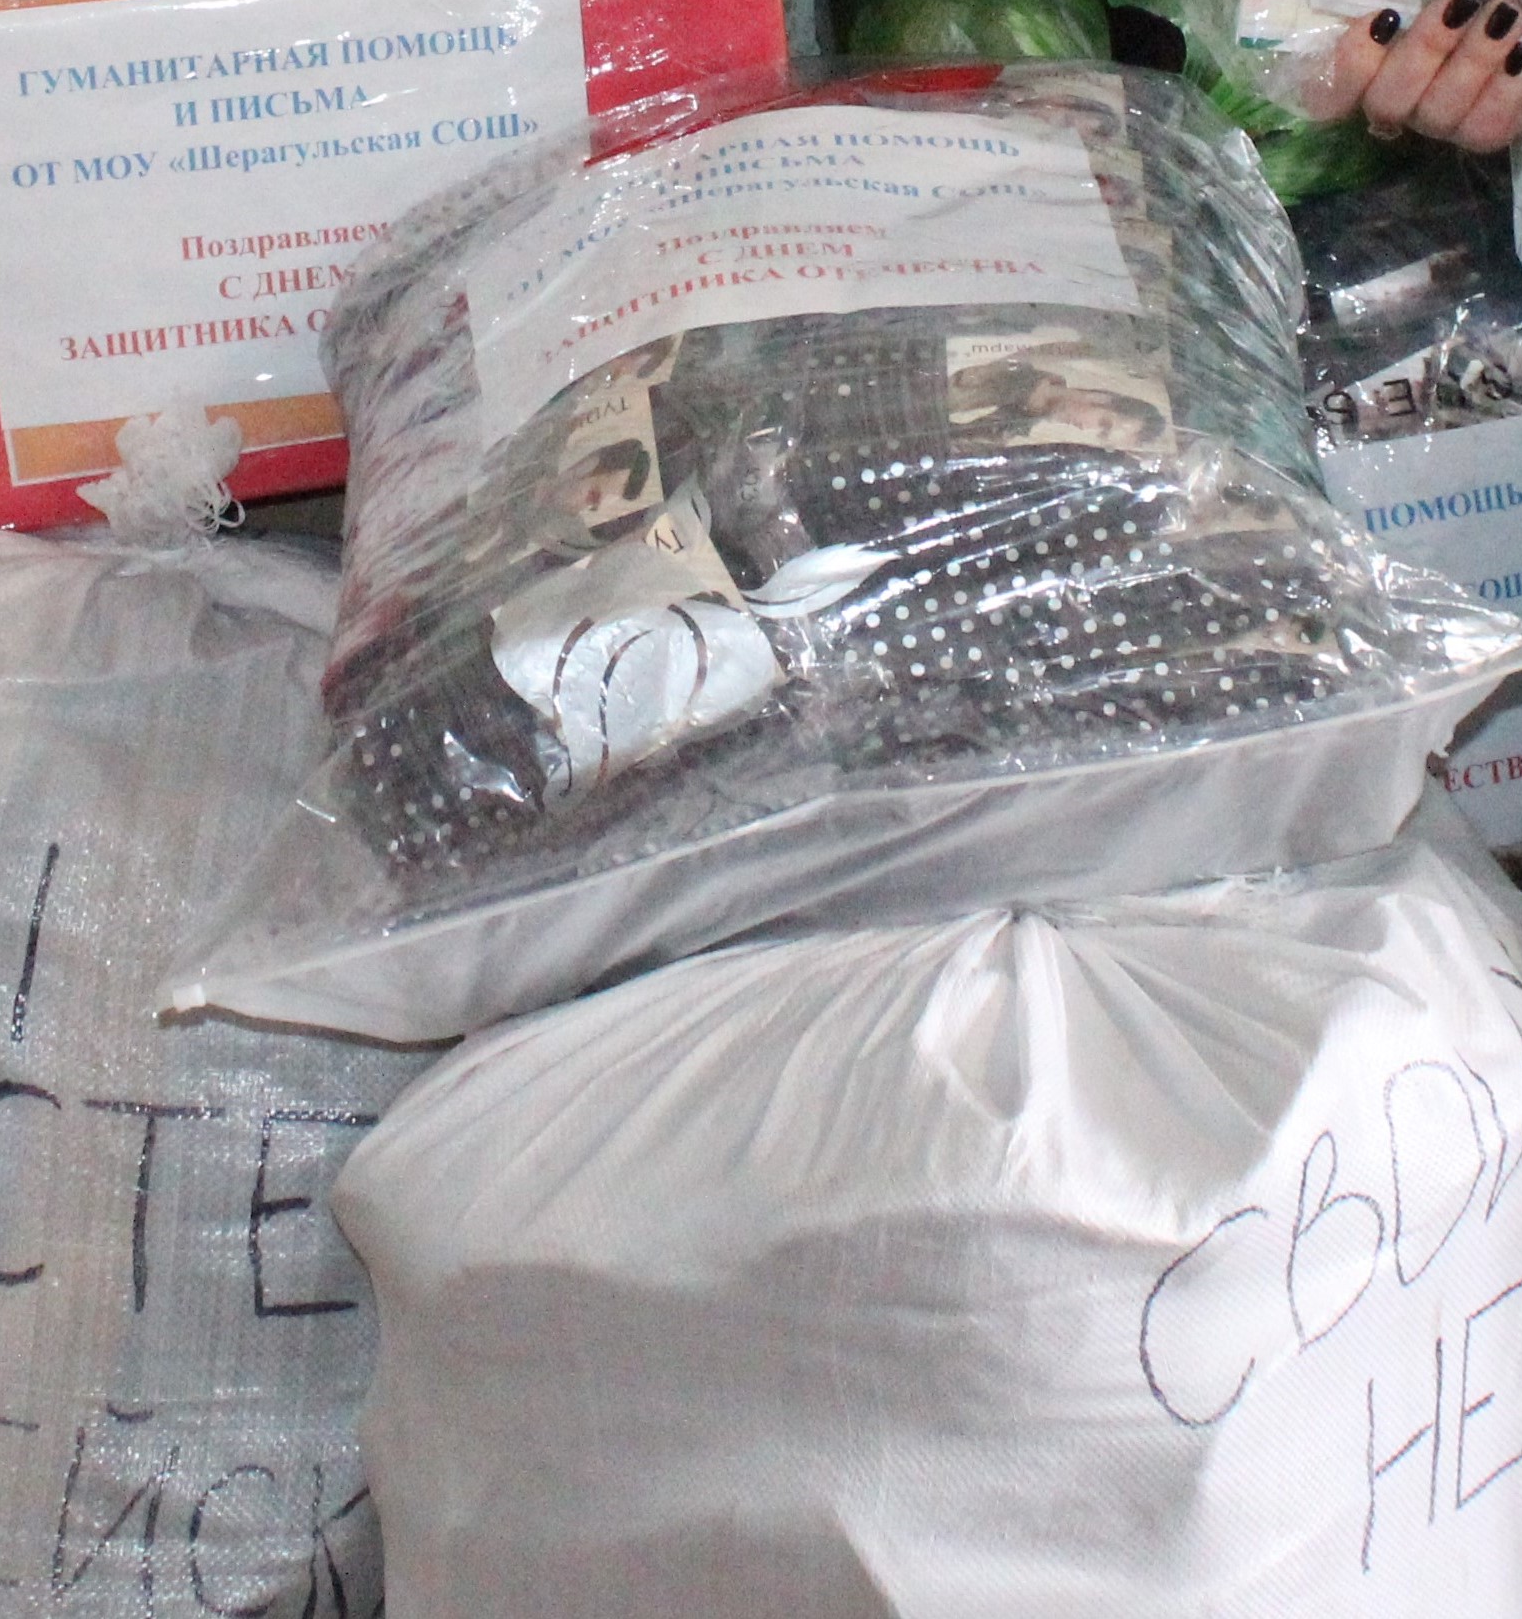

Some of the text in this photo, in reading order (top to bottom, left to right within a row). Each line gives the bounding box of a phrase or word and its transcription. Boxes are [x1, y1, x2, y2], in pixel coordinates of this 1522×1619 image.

[18, 25, 519, 97] ГУМАНИТАРНАЯ ПОМОЩЬ
[172, 85, 372, 127] И ПИСЬМА
[12, 113, 539, 189] ОТ МОУ «Шерагульская СОШ»
[834, 134, 1020, 158] ПОМОЩЬ
[181, 221, 391, 261] Поздравляем
[735, 243, 854, 262] ДНЕМ
[218, 275, 243, 300] С
[59, 314, 296, 361] ЗАЩИТНИКА
